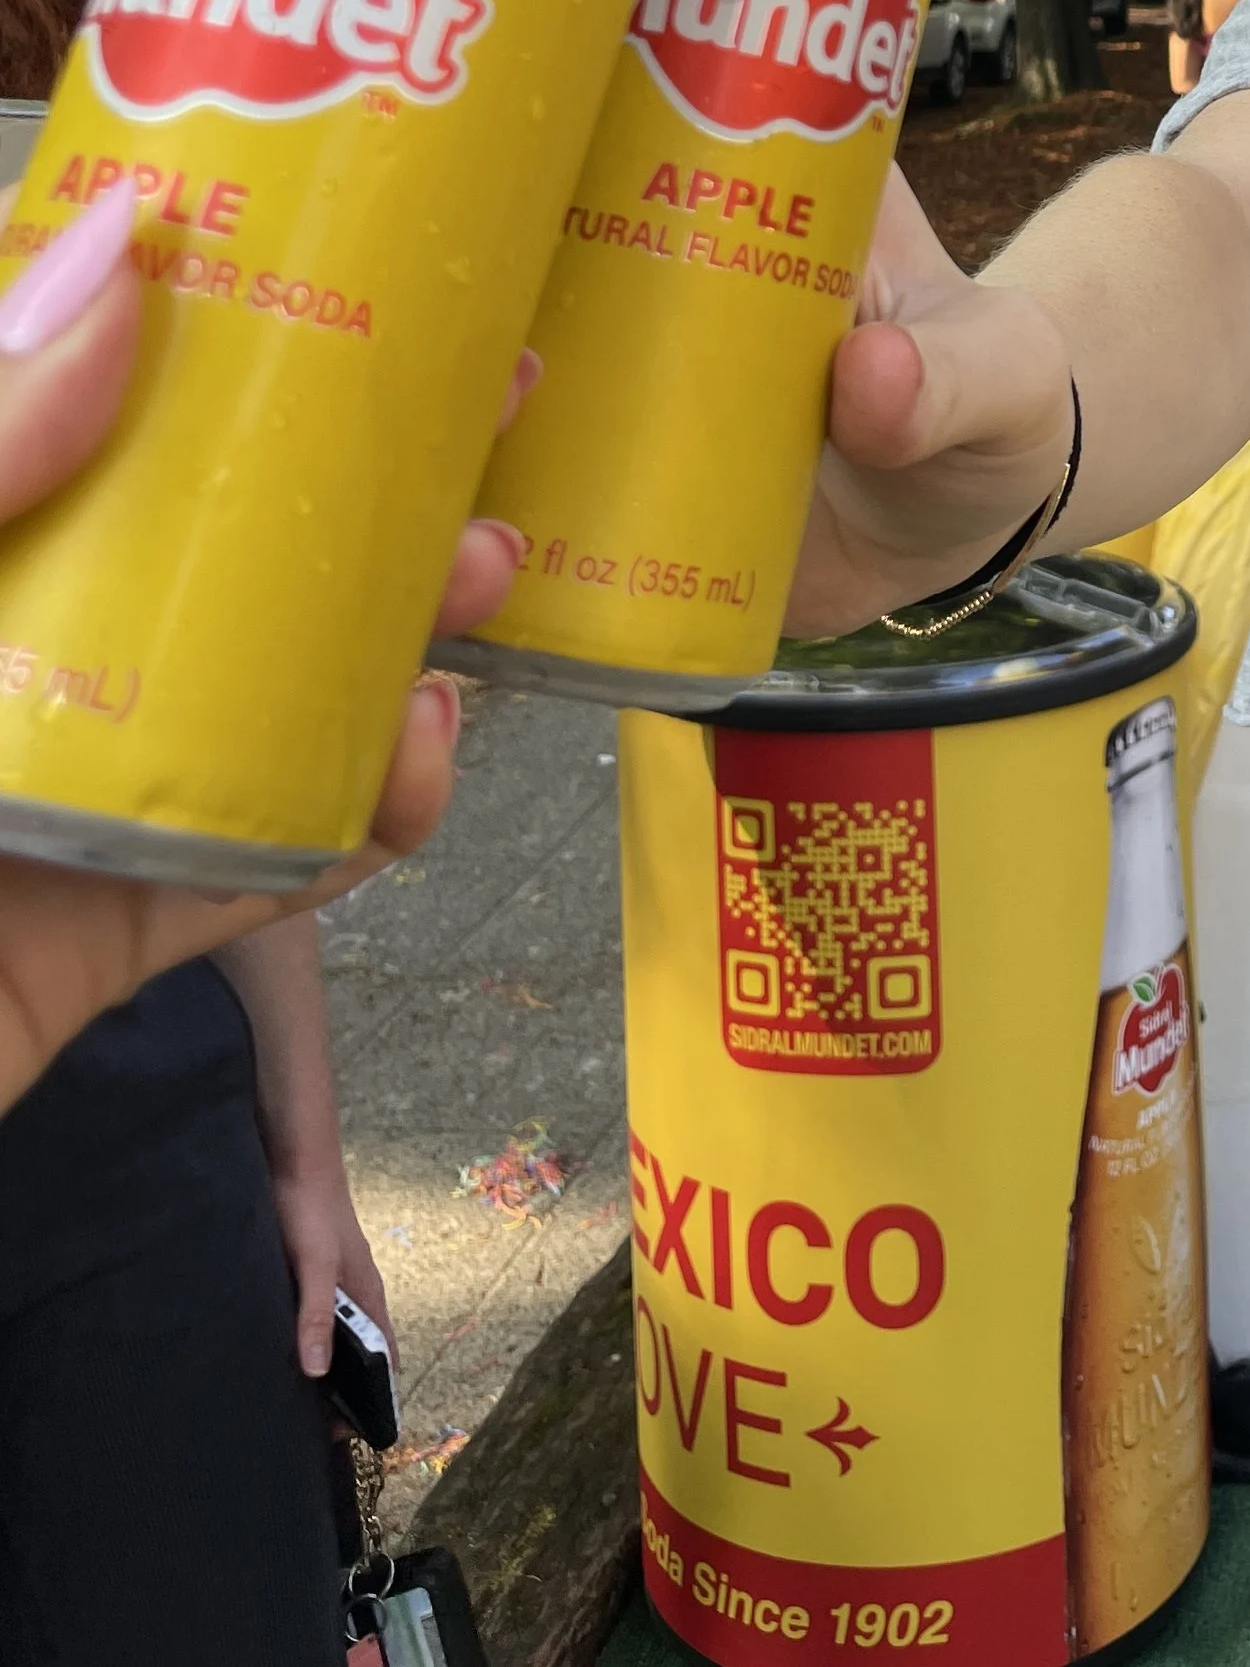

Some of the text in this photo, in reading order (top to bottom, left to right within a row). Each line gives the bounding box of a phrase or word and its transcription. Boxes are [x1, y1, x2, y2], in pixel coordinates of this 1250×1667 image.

[51, 154, 251, 237] APPLE
[641, 162, 816, 238] APPLE
[684, 230, 812, 289] FLAVOR
[248, 270, 373, 339] SODA
[543, 538, 568, 575] fl
[575, 556, 618, 585] oz
[628, 554, 702, 600] (355
[705, 570, 756, 613] mL)
[45, 664, 141, 725] mL)
[728, 1022, 933, 1059] SIDRALMUNDET.COM
[1117, 1008, 1189, 1089] Mundet
[1138, 1000, 1174, 1038] Sidral
[692, 1561, 811, 1639] Since
[830, 1599, 954, 1647] 1902
